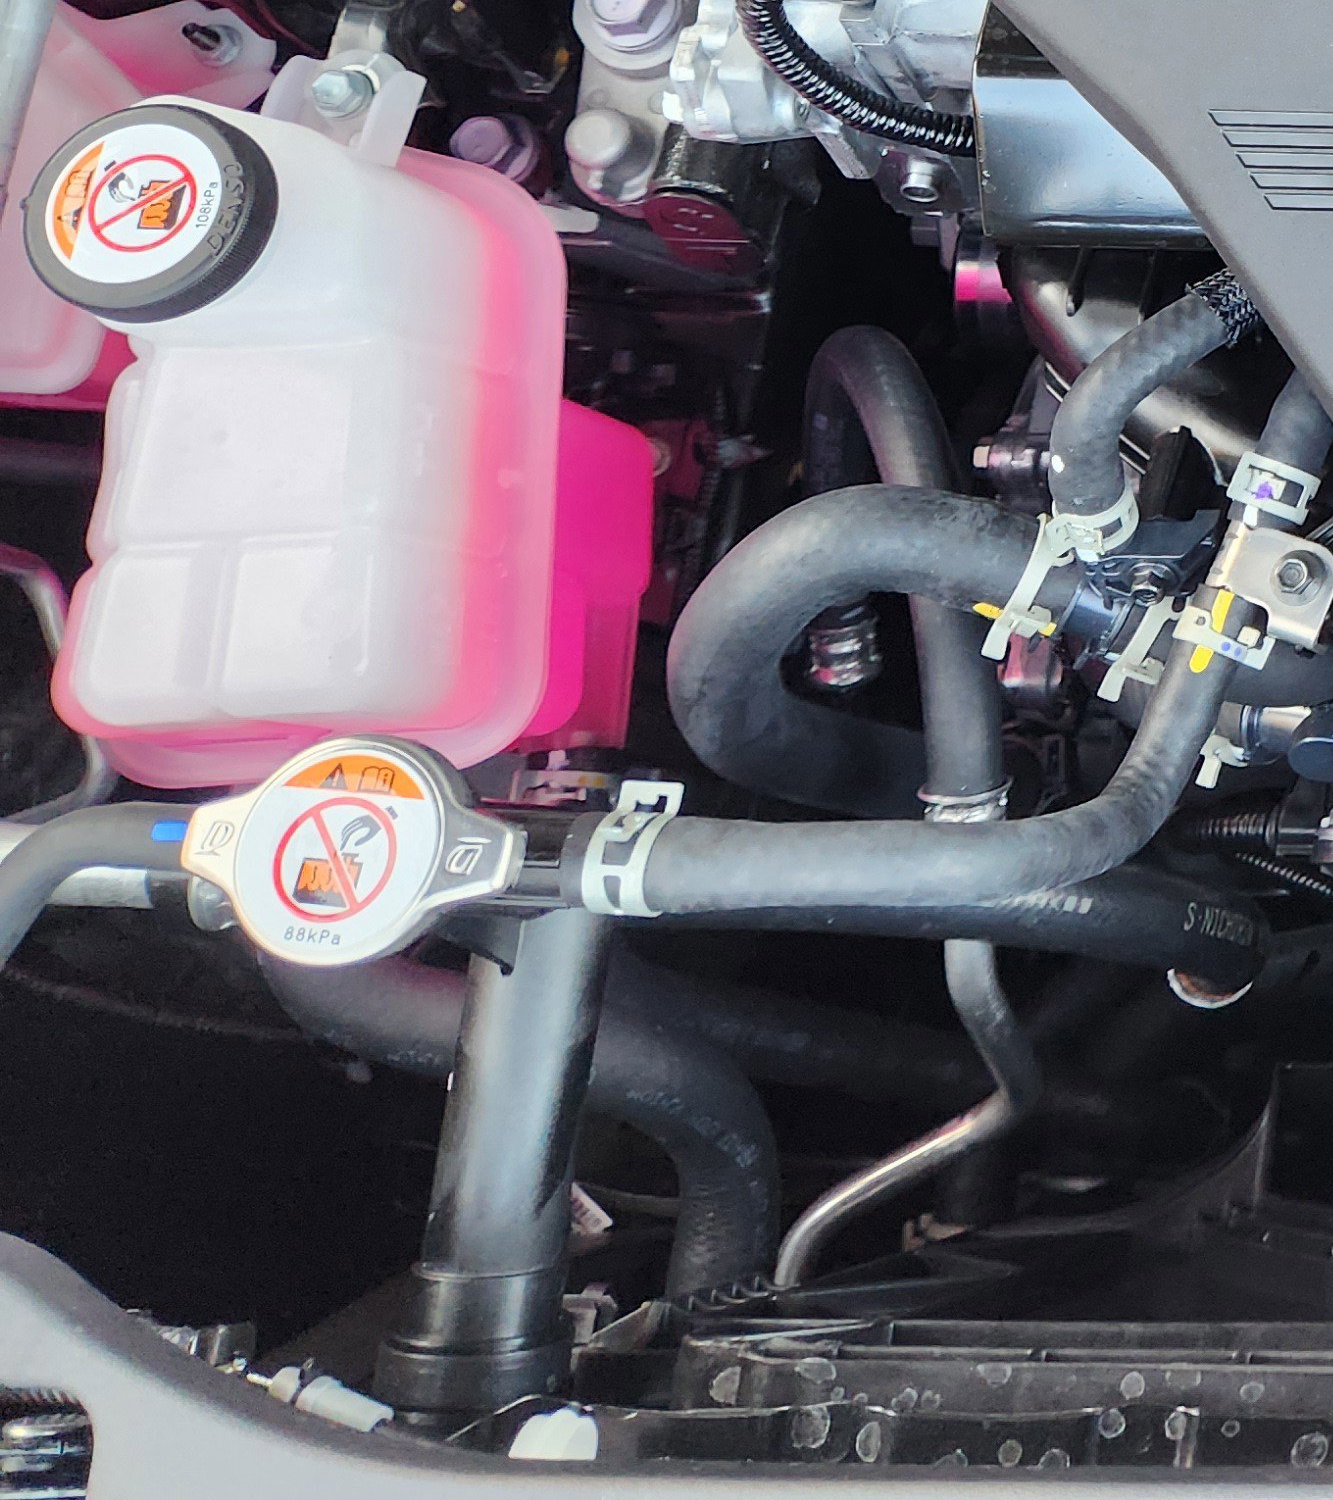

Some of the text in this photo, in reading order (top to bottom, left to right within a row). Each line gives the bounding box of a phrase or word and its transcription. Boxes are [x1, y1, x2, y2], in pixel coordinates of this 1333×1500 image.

[195, 181, 219, 229] 108kPa
[207, 161, 246, 256] DENSO
[283, 925, 341, 946] 88kPa
